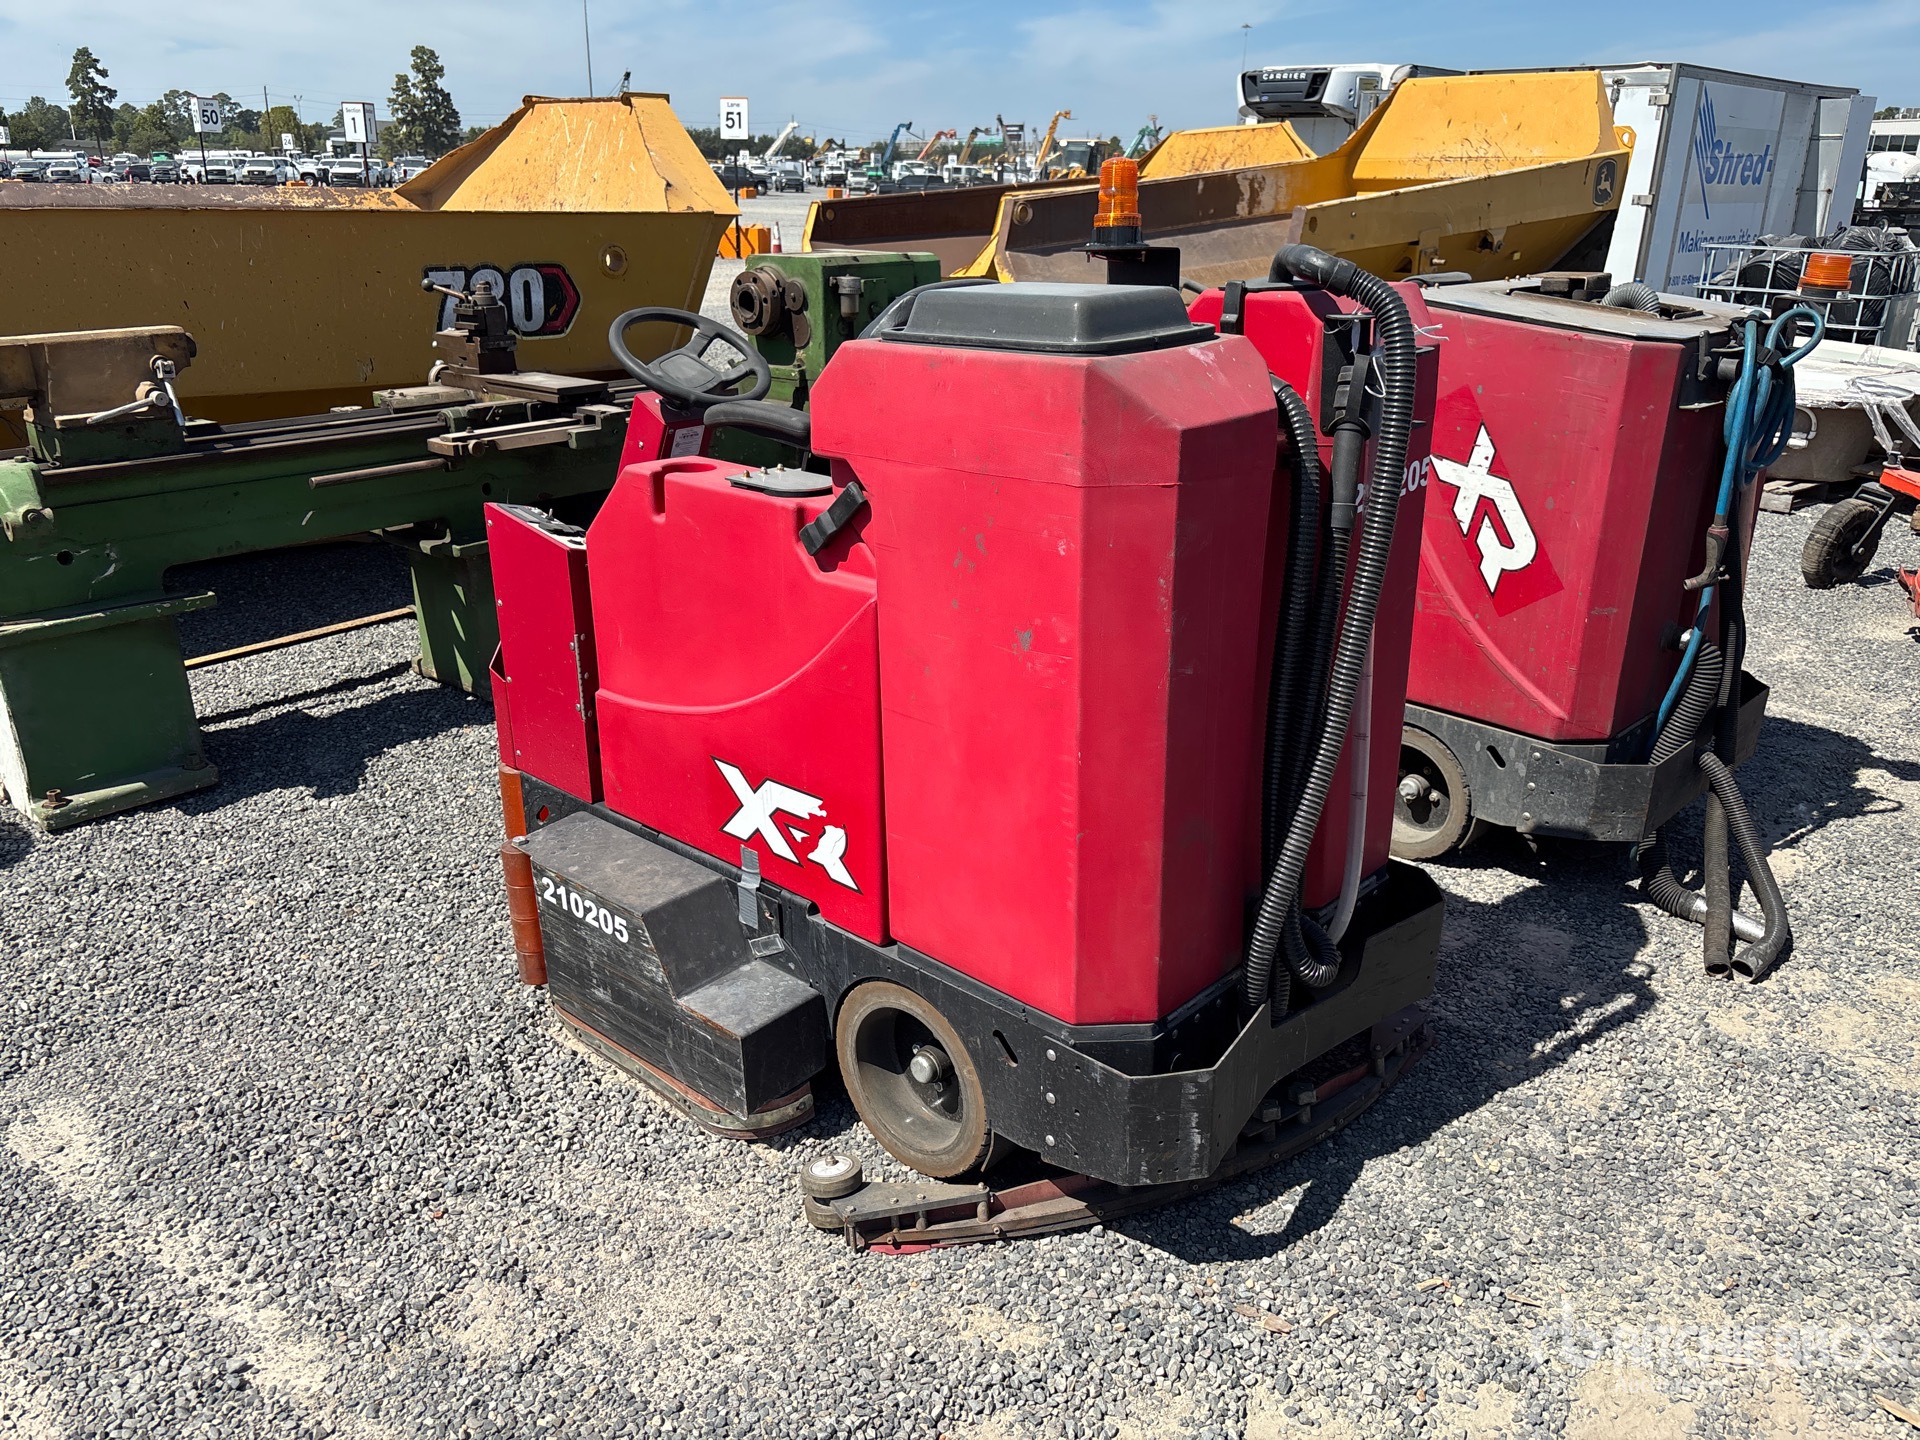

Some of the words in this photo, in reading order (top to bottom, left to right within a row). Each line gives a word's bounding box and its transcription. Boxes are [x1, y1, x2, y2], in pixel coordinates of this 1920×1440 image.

[1262, 72, 1307, 81] CARRIER
[201, 108, 219, 125] 50
[351, 117, 357, 133] 1
[725, 111, 742, 129] 51
[541, 876, 629, 944] 210205
